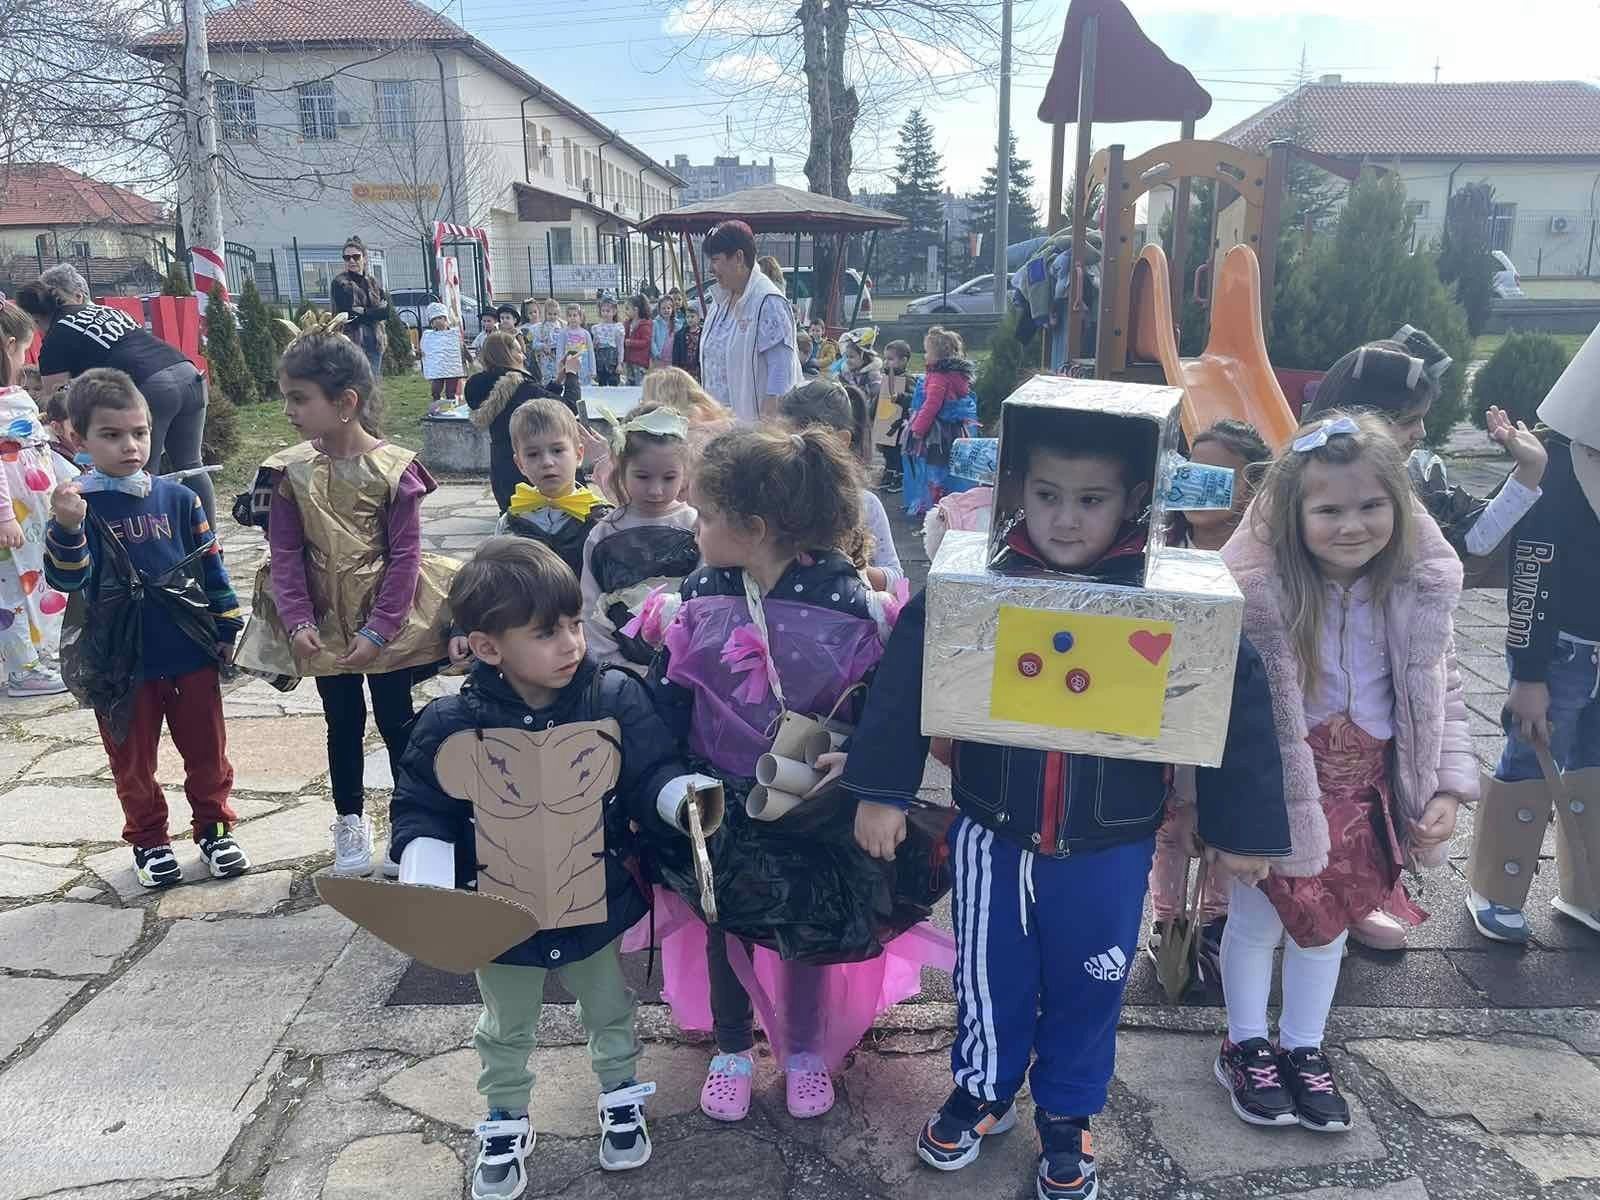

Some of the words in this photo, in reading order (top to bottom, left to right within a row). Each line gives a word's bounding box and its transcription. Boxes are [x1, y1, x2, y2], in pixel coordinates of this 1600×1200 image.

[84, 308, 142, 349] Roll
[107, 513, 172, 543] FUN
[1506, 540, 1554, 648] Revision
